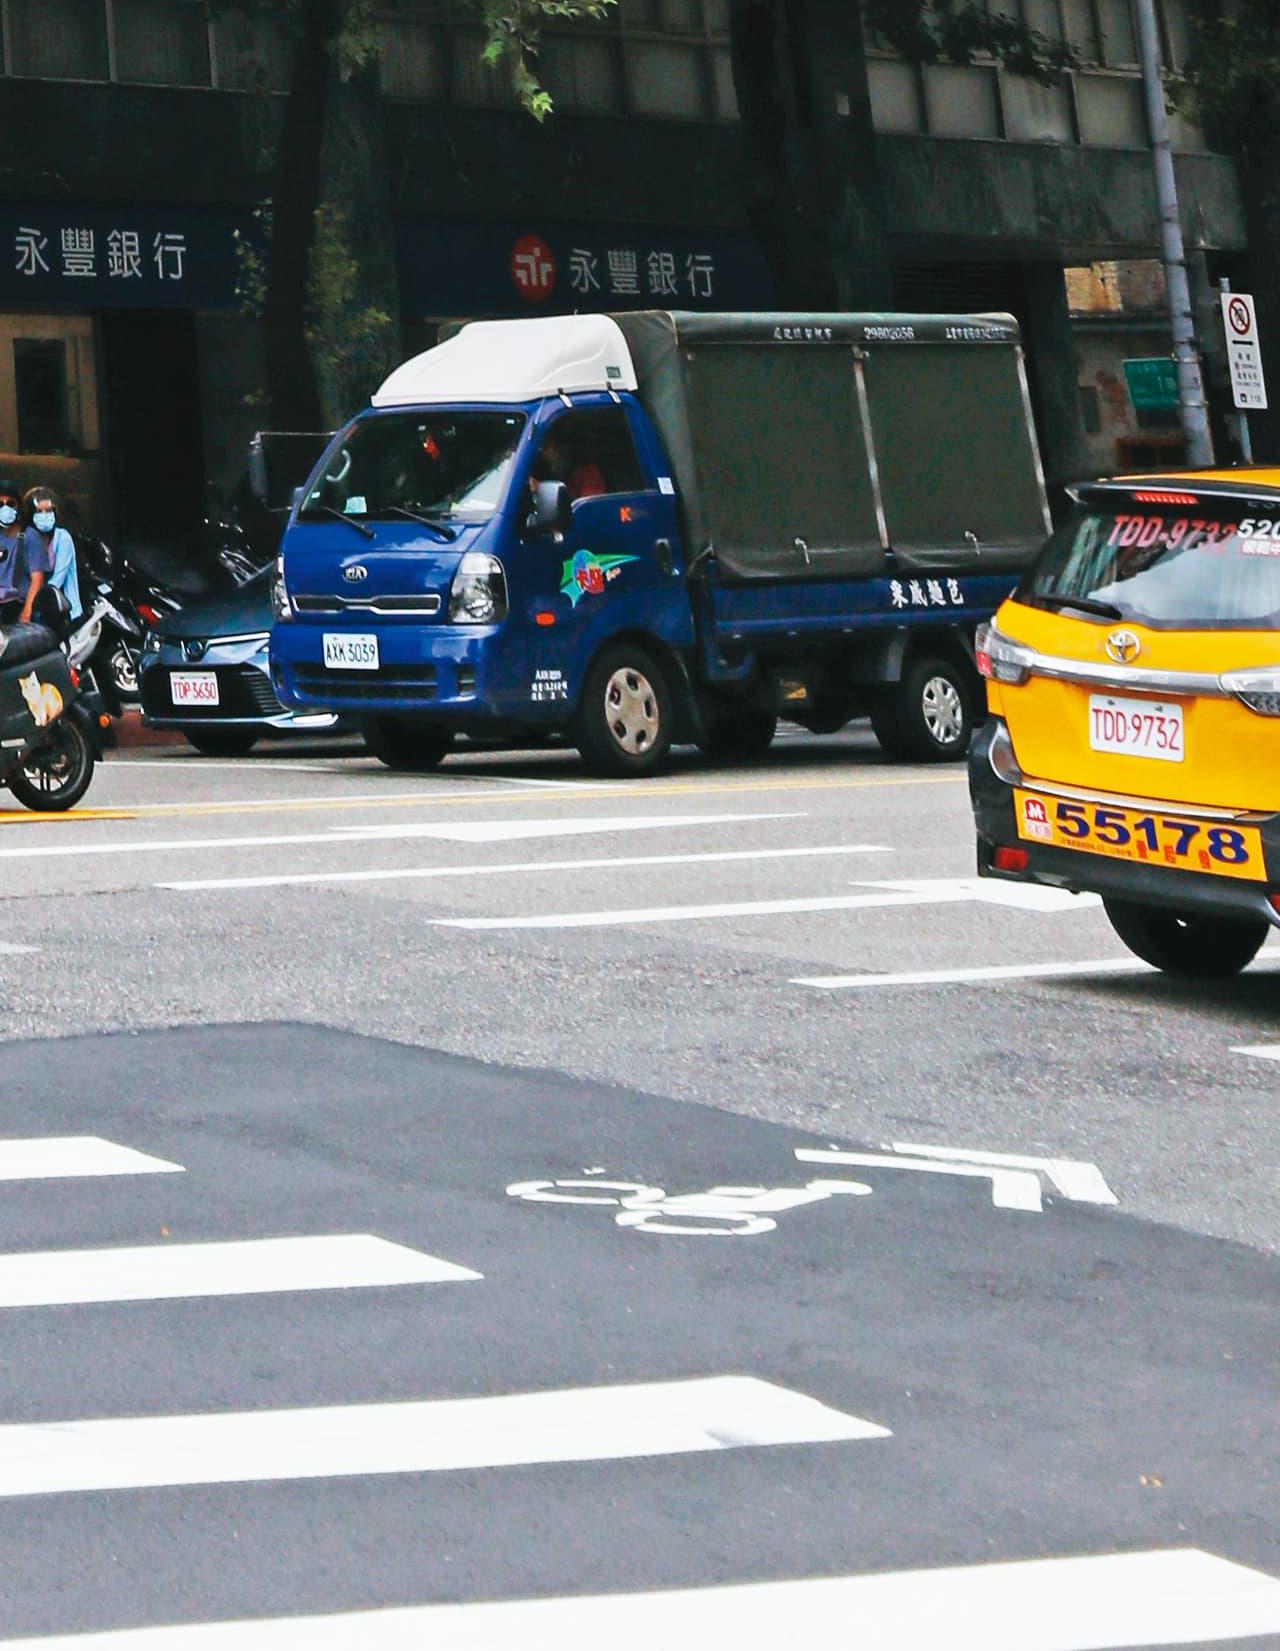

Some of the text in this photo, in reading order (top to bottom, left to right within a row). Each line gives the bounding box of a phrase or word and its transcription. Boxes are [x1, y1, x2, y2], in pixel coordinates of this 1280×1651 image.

[15, 226, 187, 280] 永豐銀行
[570, 248, 714, 298] 永豐銀行
[1107, 514, 1238, 554] TDD-9732
[1056, 803, 1249, 864] 55178
